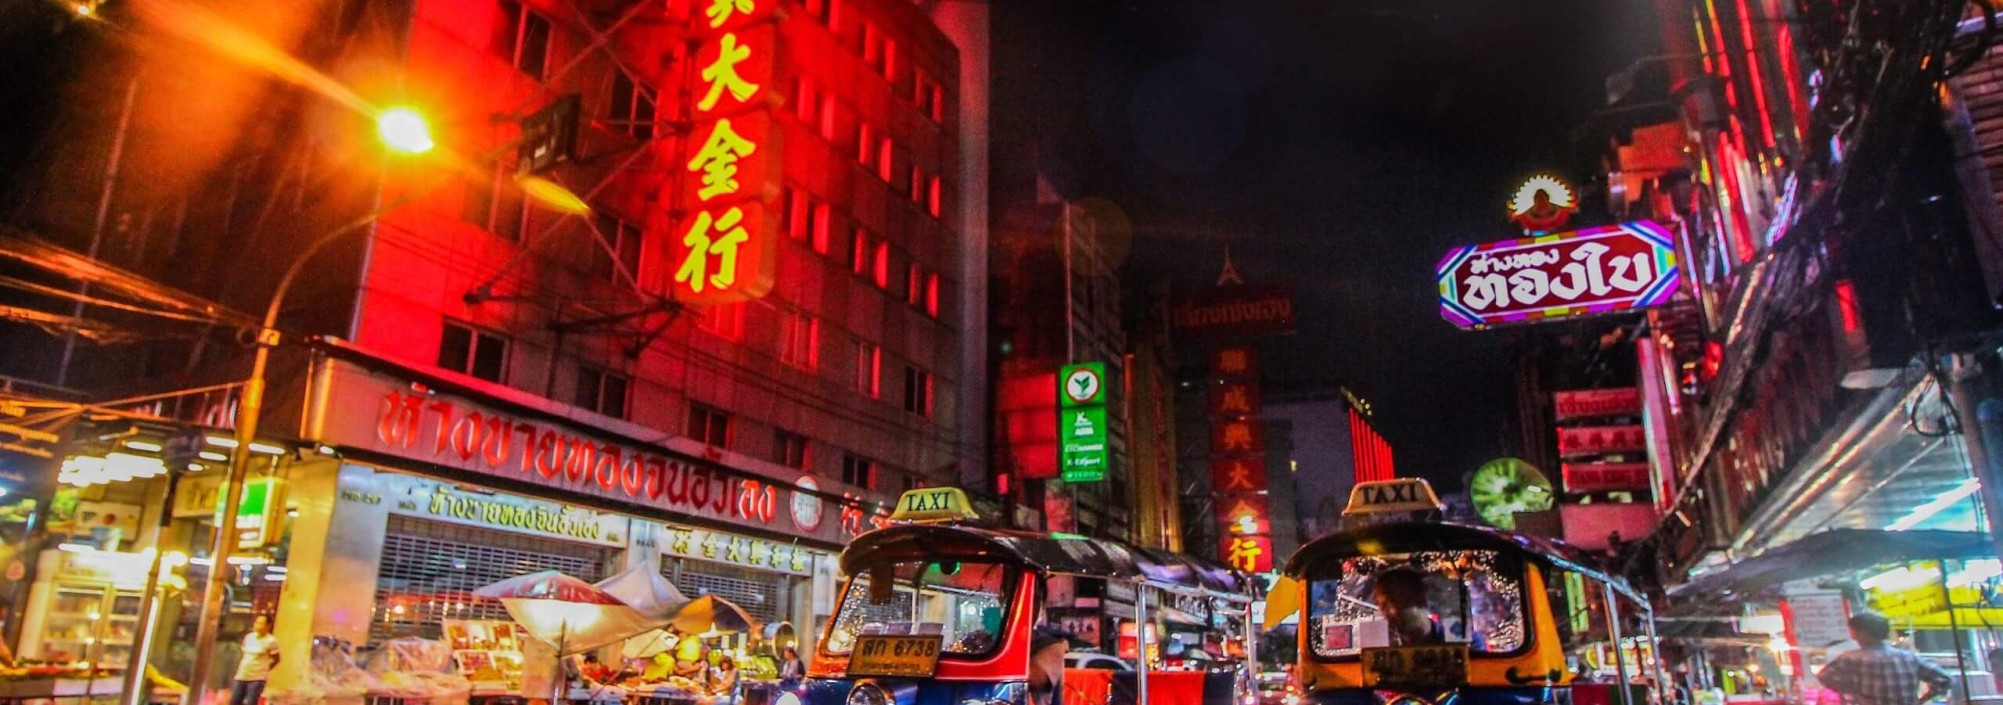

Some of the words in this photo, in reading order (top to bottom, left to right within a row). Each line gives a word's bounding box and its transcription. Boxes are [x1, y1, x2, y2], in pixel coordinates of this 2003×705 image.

[905, 492, 950, 511] TAXI
[1358, 483, 1418, 504] TAXI
[894, 639, 935, 656] 6738
